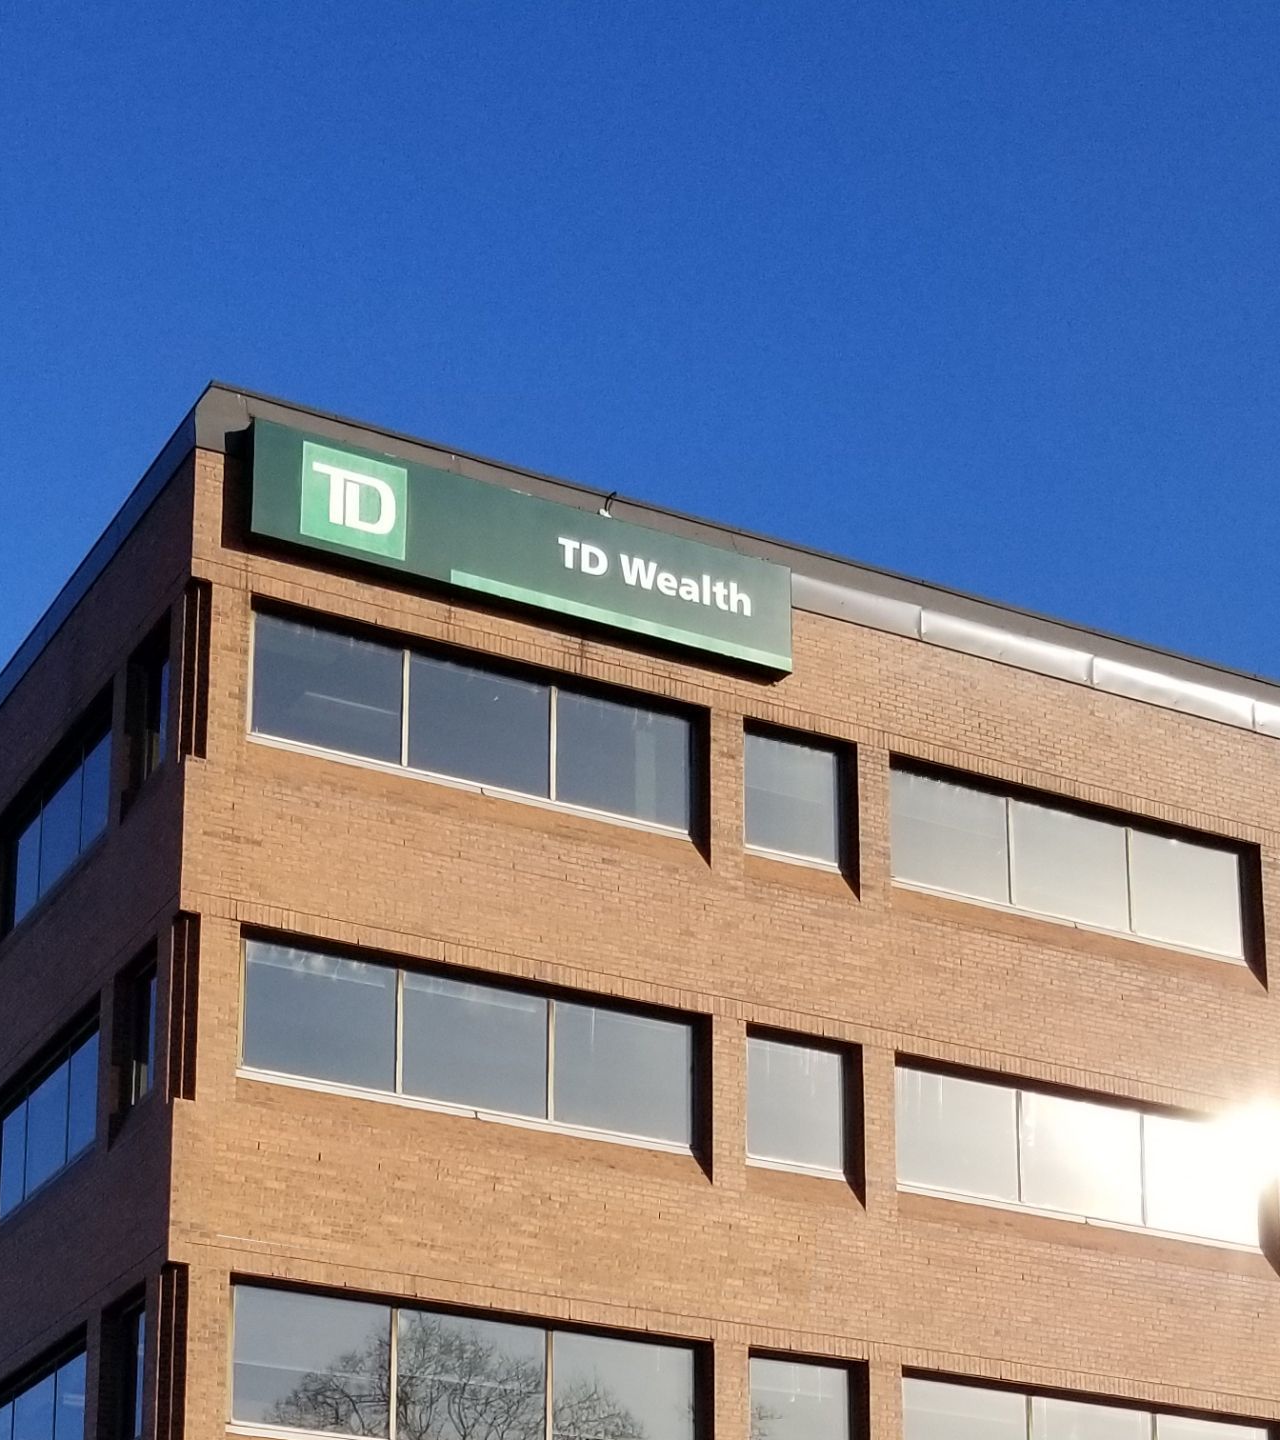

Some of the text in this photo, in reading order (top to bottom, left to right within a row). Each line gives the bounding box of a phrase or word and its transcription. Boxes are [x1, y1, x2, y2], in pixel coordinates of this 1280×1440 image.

[312, 460, 397, 535] TD
[558, 536, 752, 617] TD Wealth
